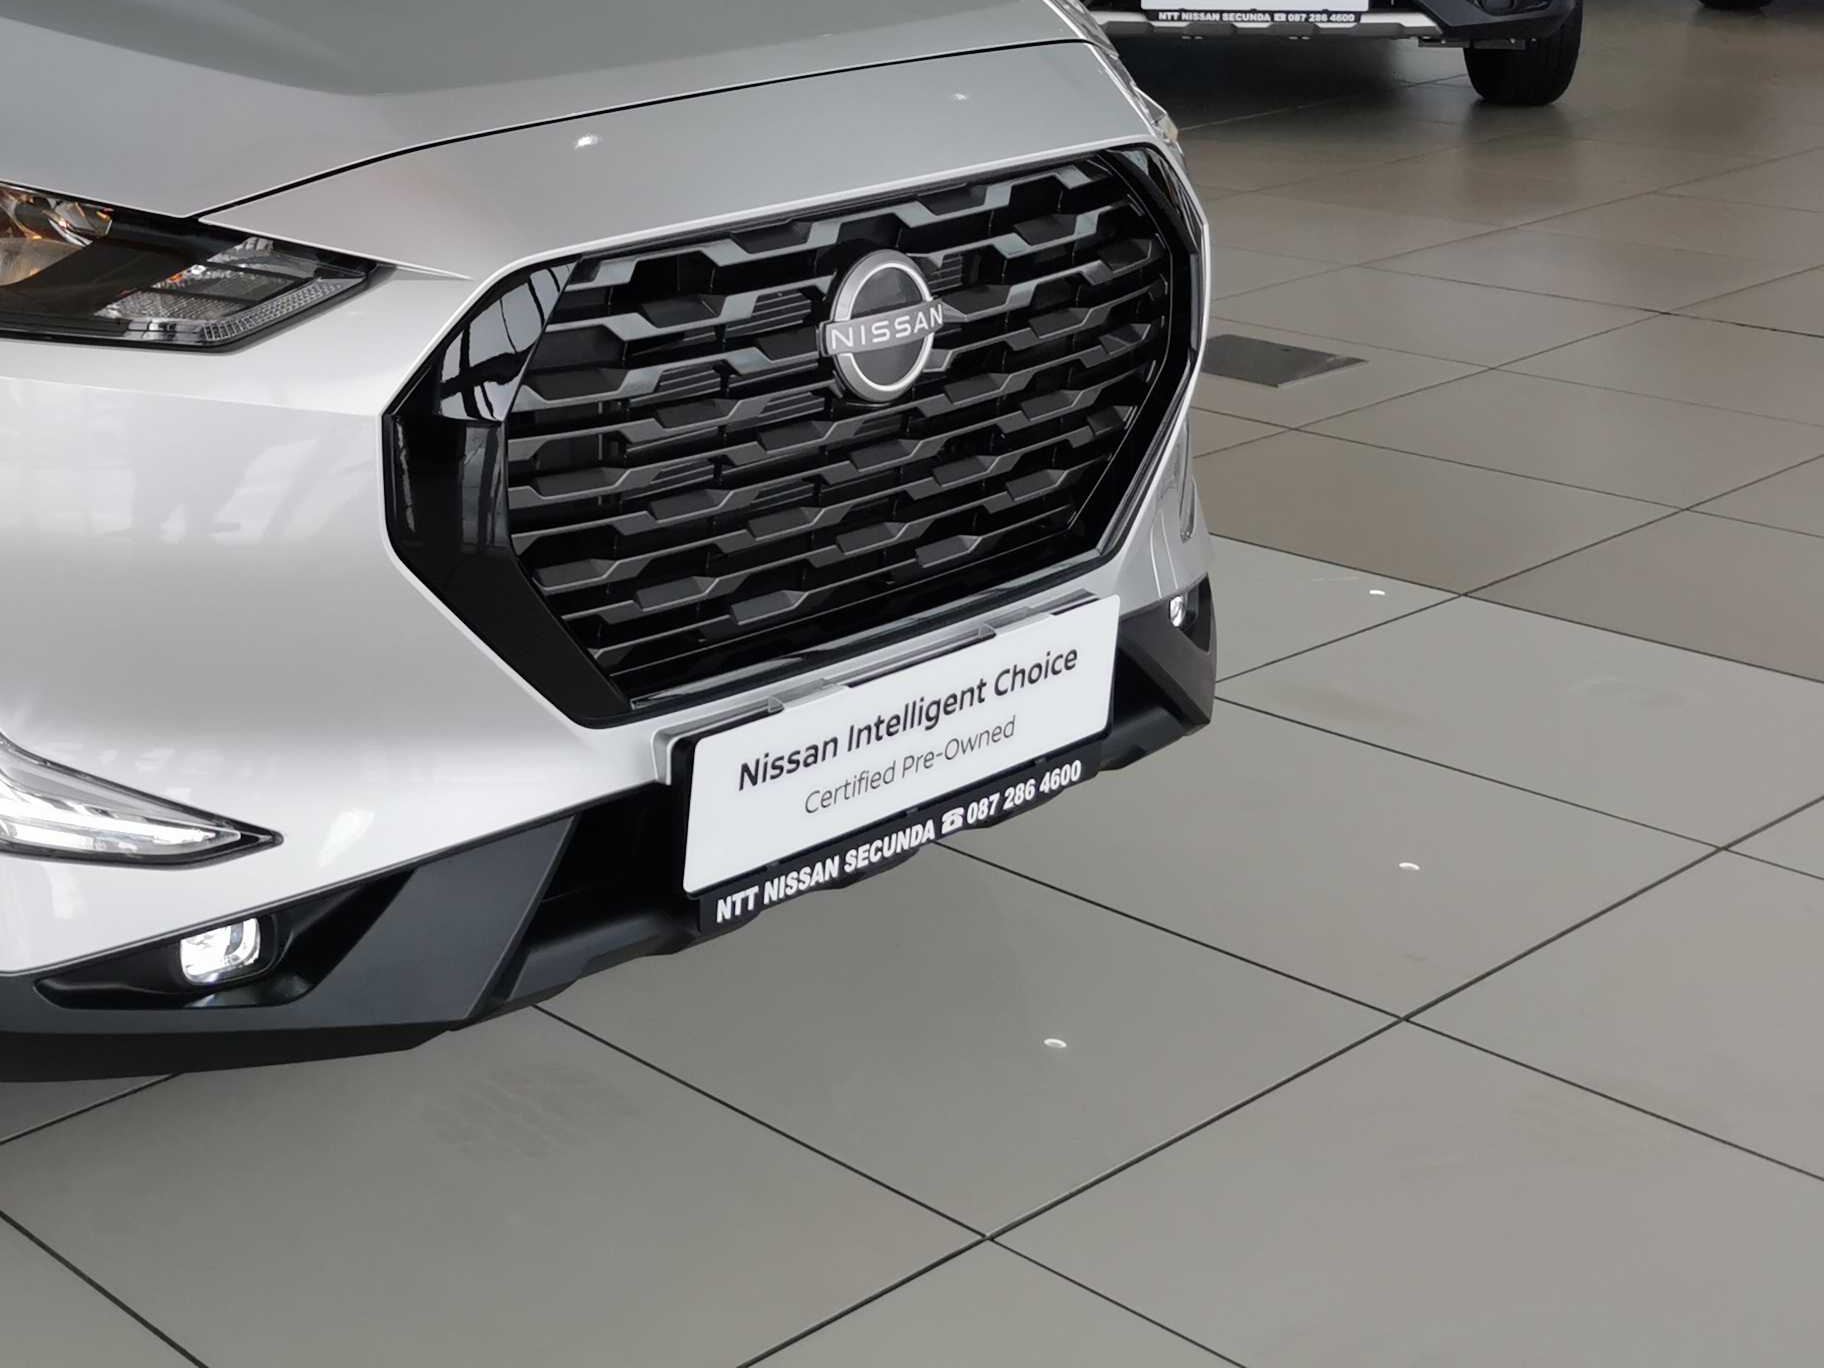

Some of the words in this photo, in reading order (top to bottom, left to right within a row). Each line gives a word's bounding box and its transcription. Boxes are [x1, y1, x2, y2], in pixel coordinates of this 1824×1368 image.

[1158, 11, 1179, 21] NTT
[1181, 11, 1220, 22] NISSAN
[1222, 12, 1271, 22] SECUNDA
[831, 303, 944, 350] NISSAN
[738, 735, 838, 790] Nissan
[846, 676, 986, 752] Intelligent
[993, 648, 1078, 697] Choice
[804, 759, 896, 814] Certified
[901, 714, 1016, 780] Pre-Owned
[716, 885, 759, 923] NTT
[763, 855, 840, 905] NISSAN
[843, 818, 935, 873] SECUNDA
[966, 792, 1000, 824] 087
[1003, 779, 1036, 810] 286
[1039, 759, 1082, 794] 4600
